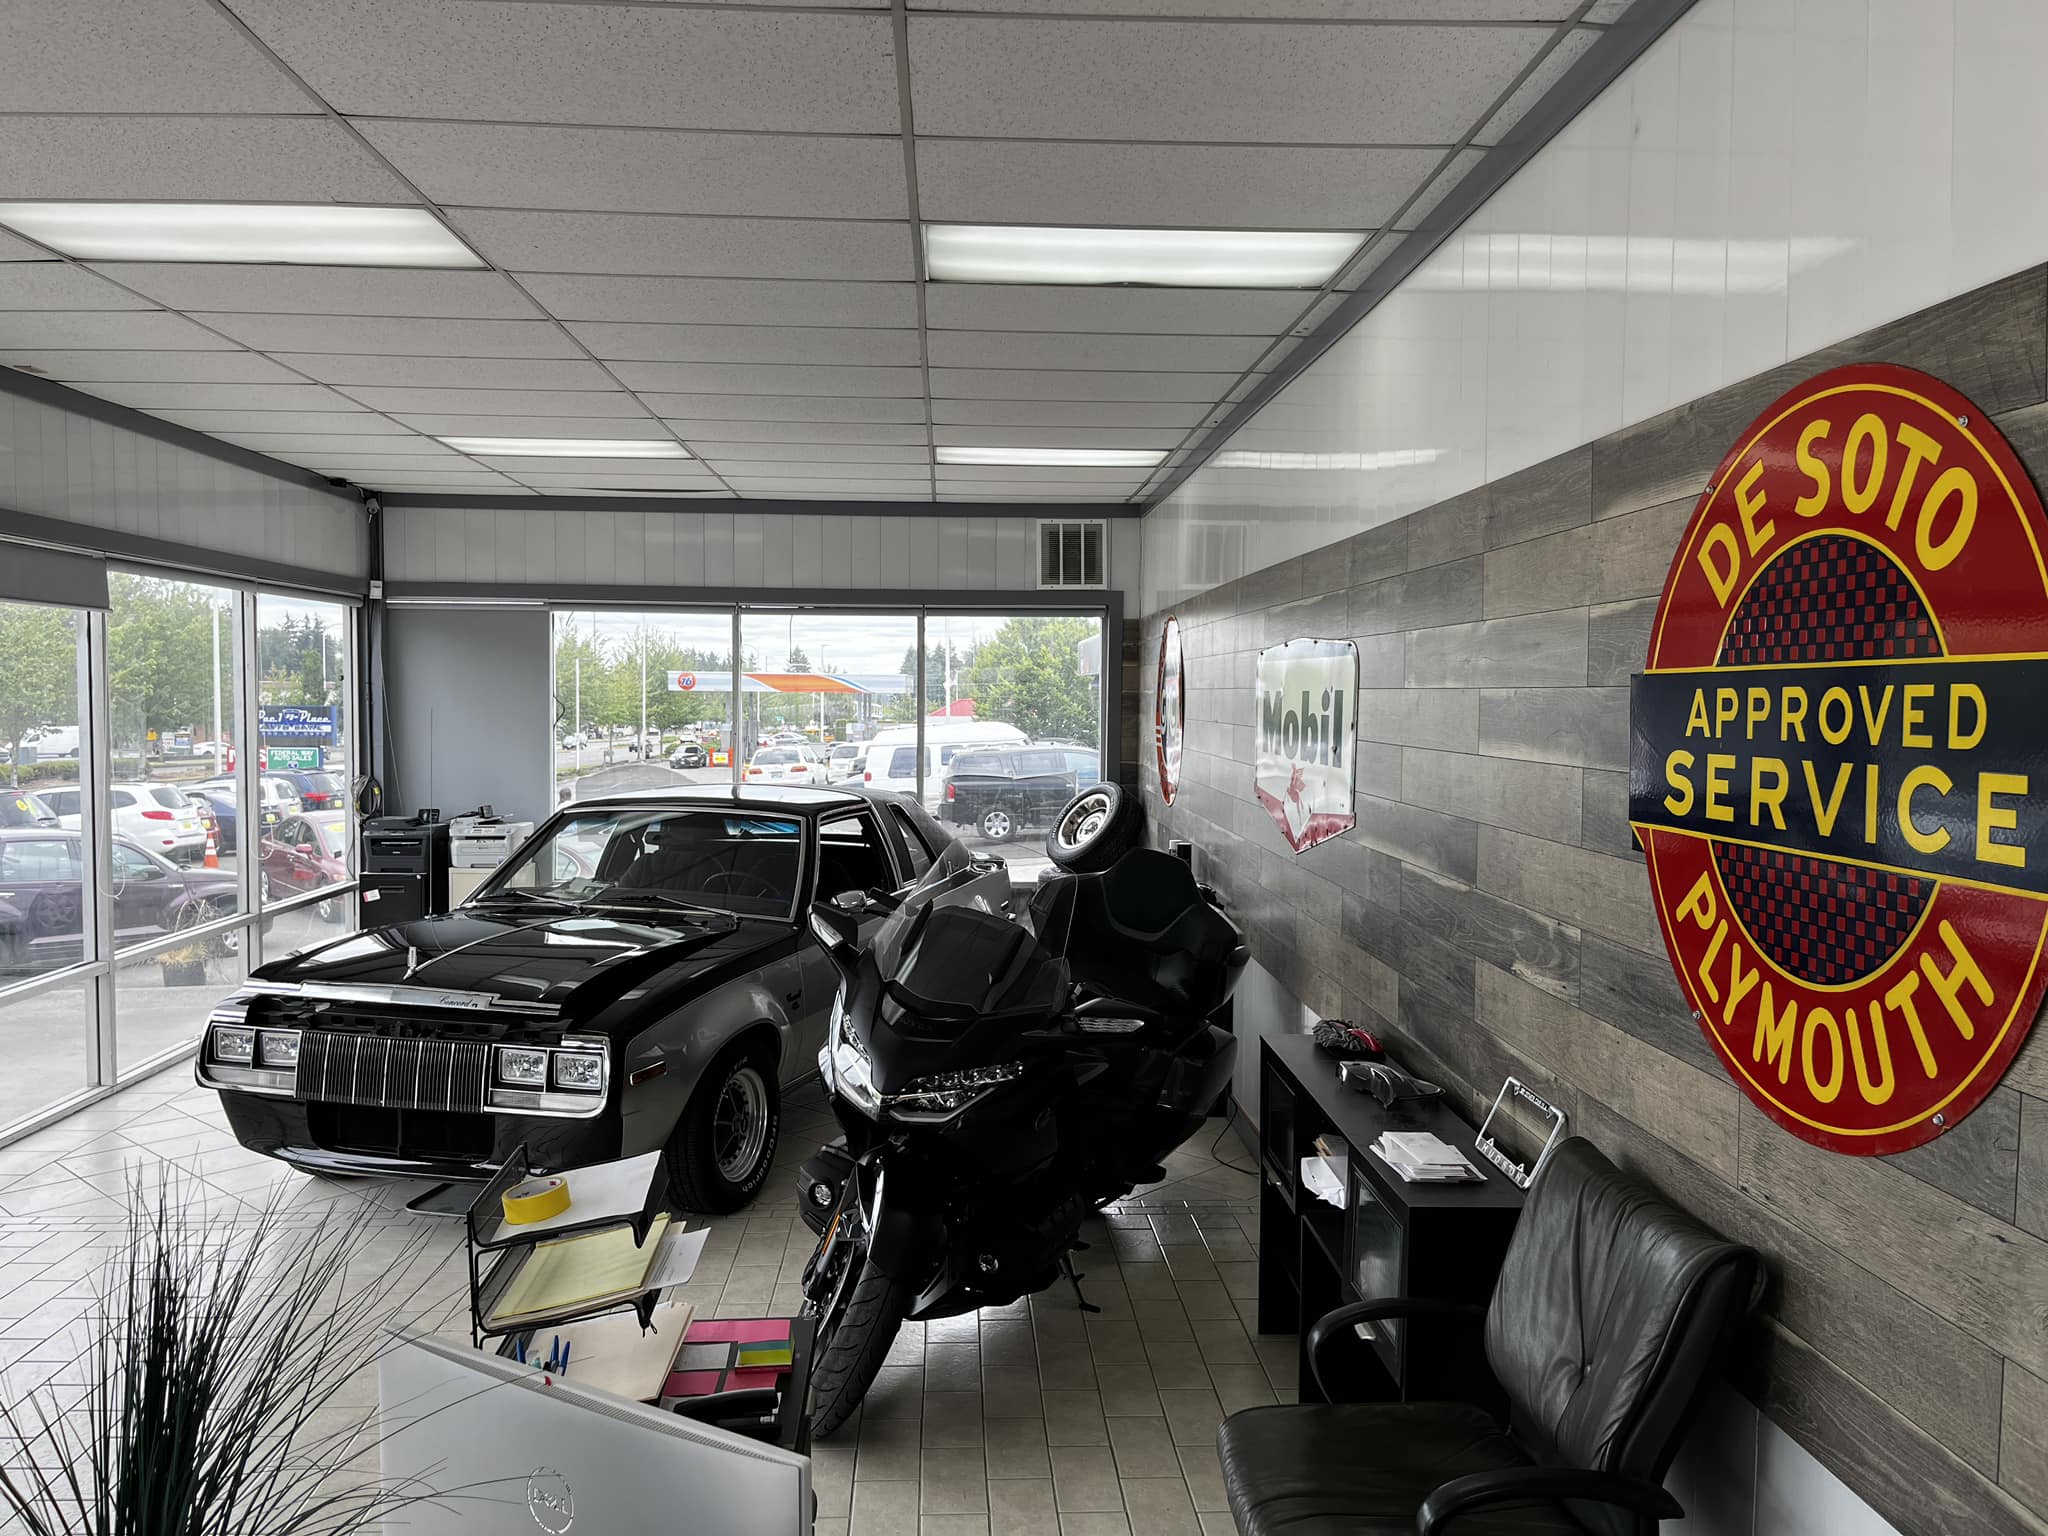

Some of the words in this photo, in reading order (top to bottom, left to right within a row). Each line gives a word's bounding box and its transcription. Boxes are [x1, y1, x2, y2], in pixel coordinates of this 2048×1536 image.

[1697, 460, 1776, 608] DE
[1795, 412, 1978, 571] SOTO
[1263, 688, 1344, 769] Mobil
[1685, 683, 1988, 750] APPROVED
[1663, 750, 2029, 868] SERVICE
[1676, 870, 1995, 1106] PLYMOUTH
[1482, 1143, 1523, 1184] HUDSON
[533, 1488, 569, 1514] DELL
